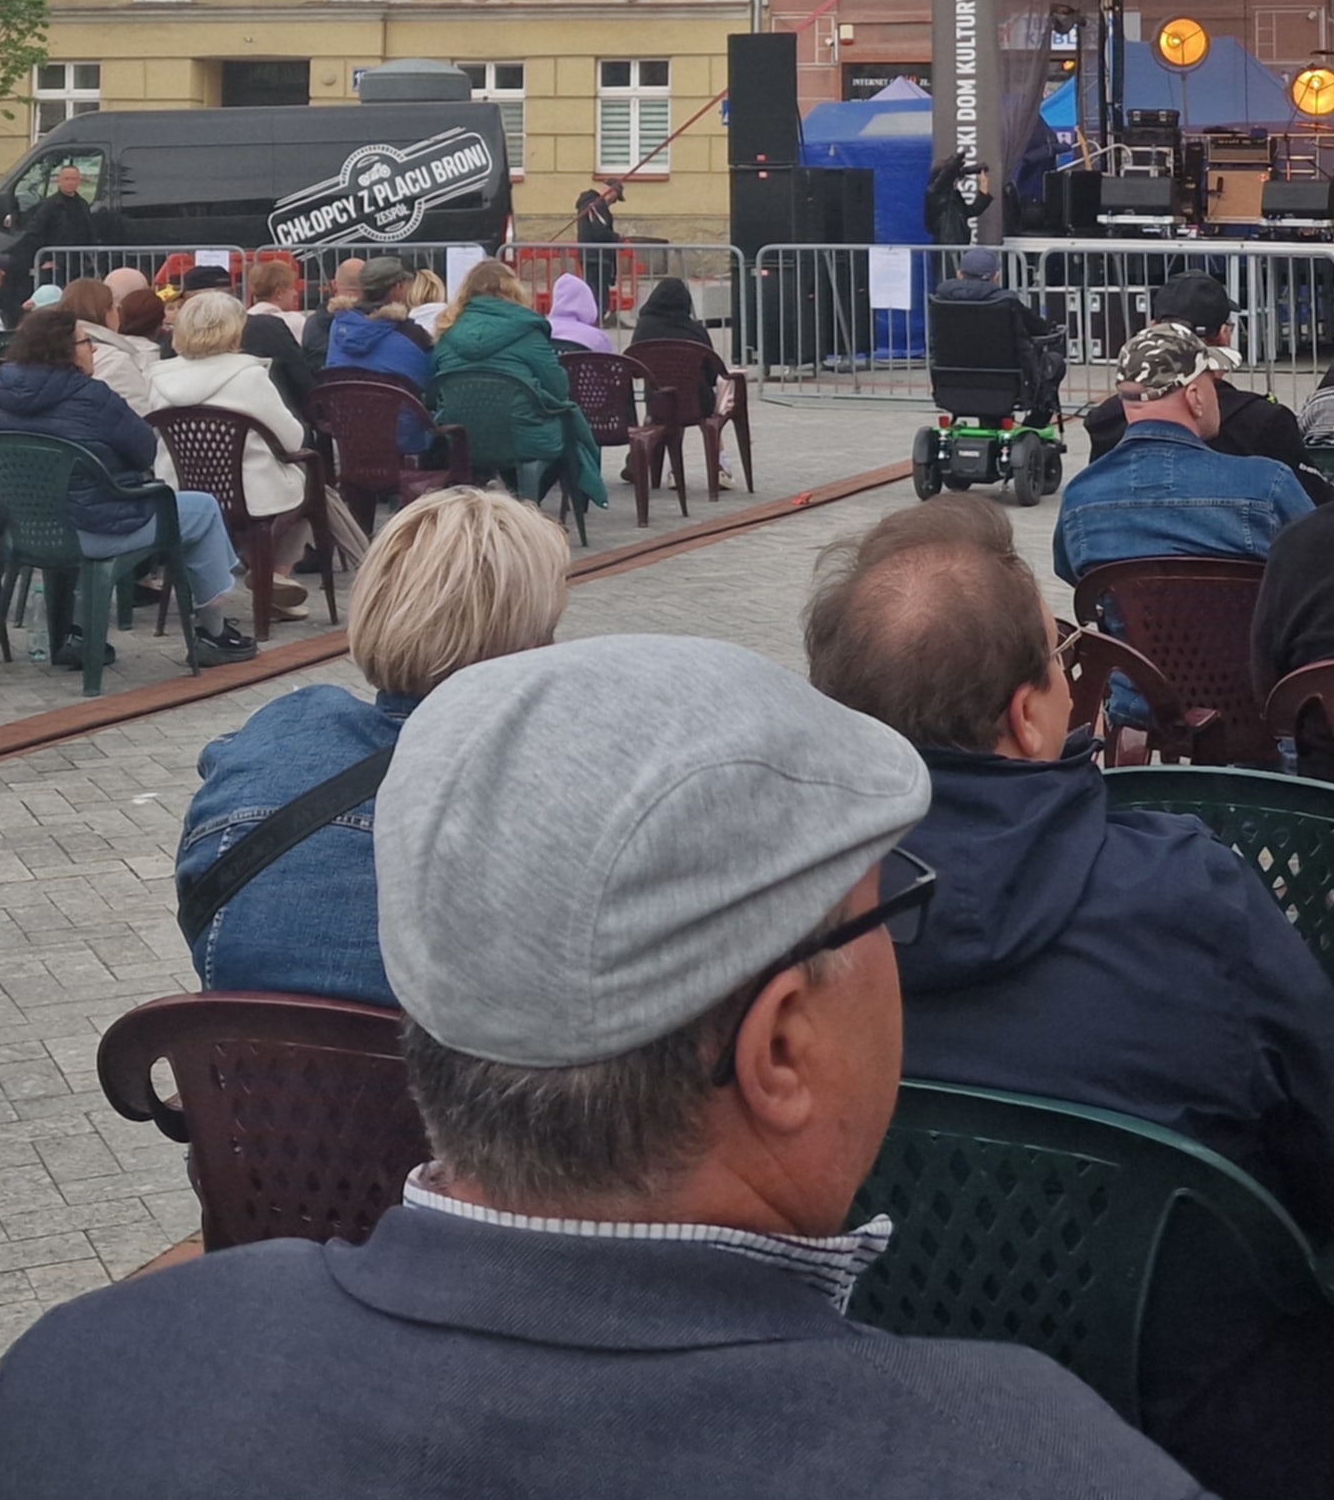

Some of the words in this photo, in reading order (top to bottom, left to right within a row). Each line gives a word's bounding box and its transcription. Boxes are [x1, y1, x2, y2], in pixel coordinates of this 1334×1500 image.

[956, 80, 977, 121] DOM
[276, 195, 357, 246] CHŁOPCY
[357, 190, 376, 214] Z
[372, 165, 432, 208] PLACU
[430, 143, 487, 184] BRONI
[374, 203, 412, 226] ZESPÓŁ
